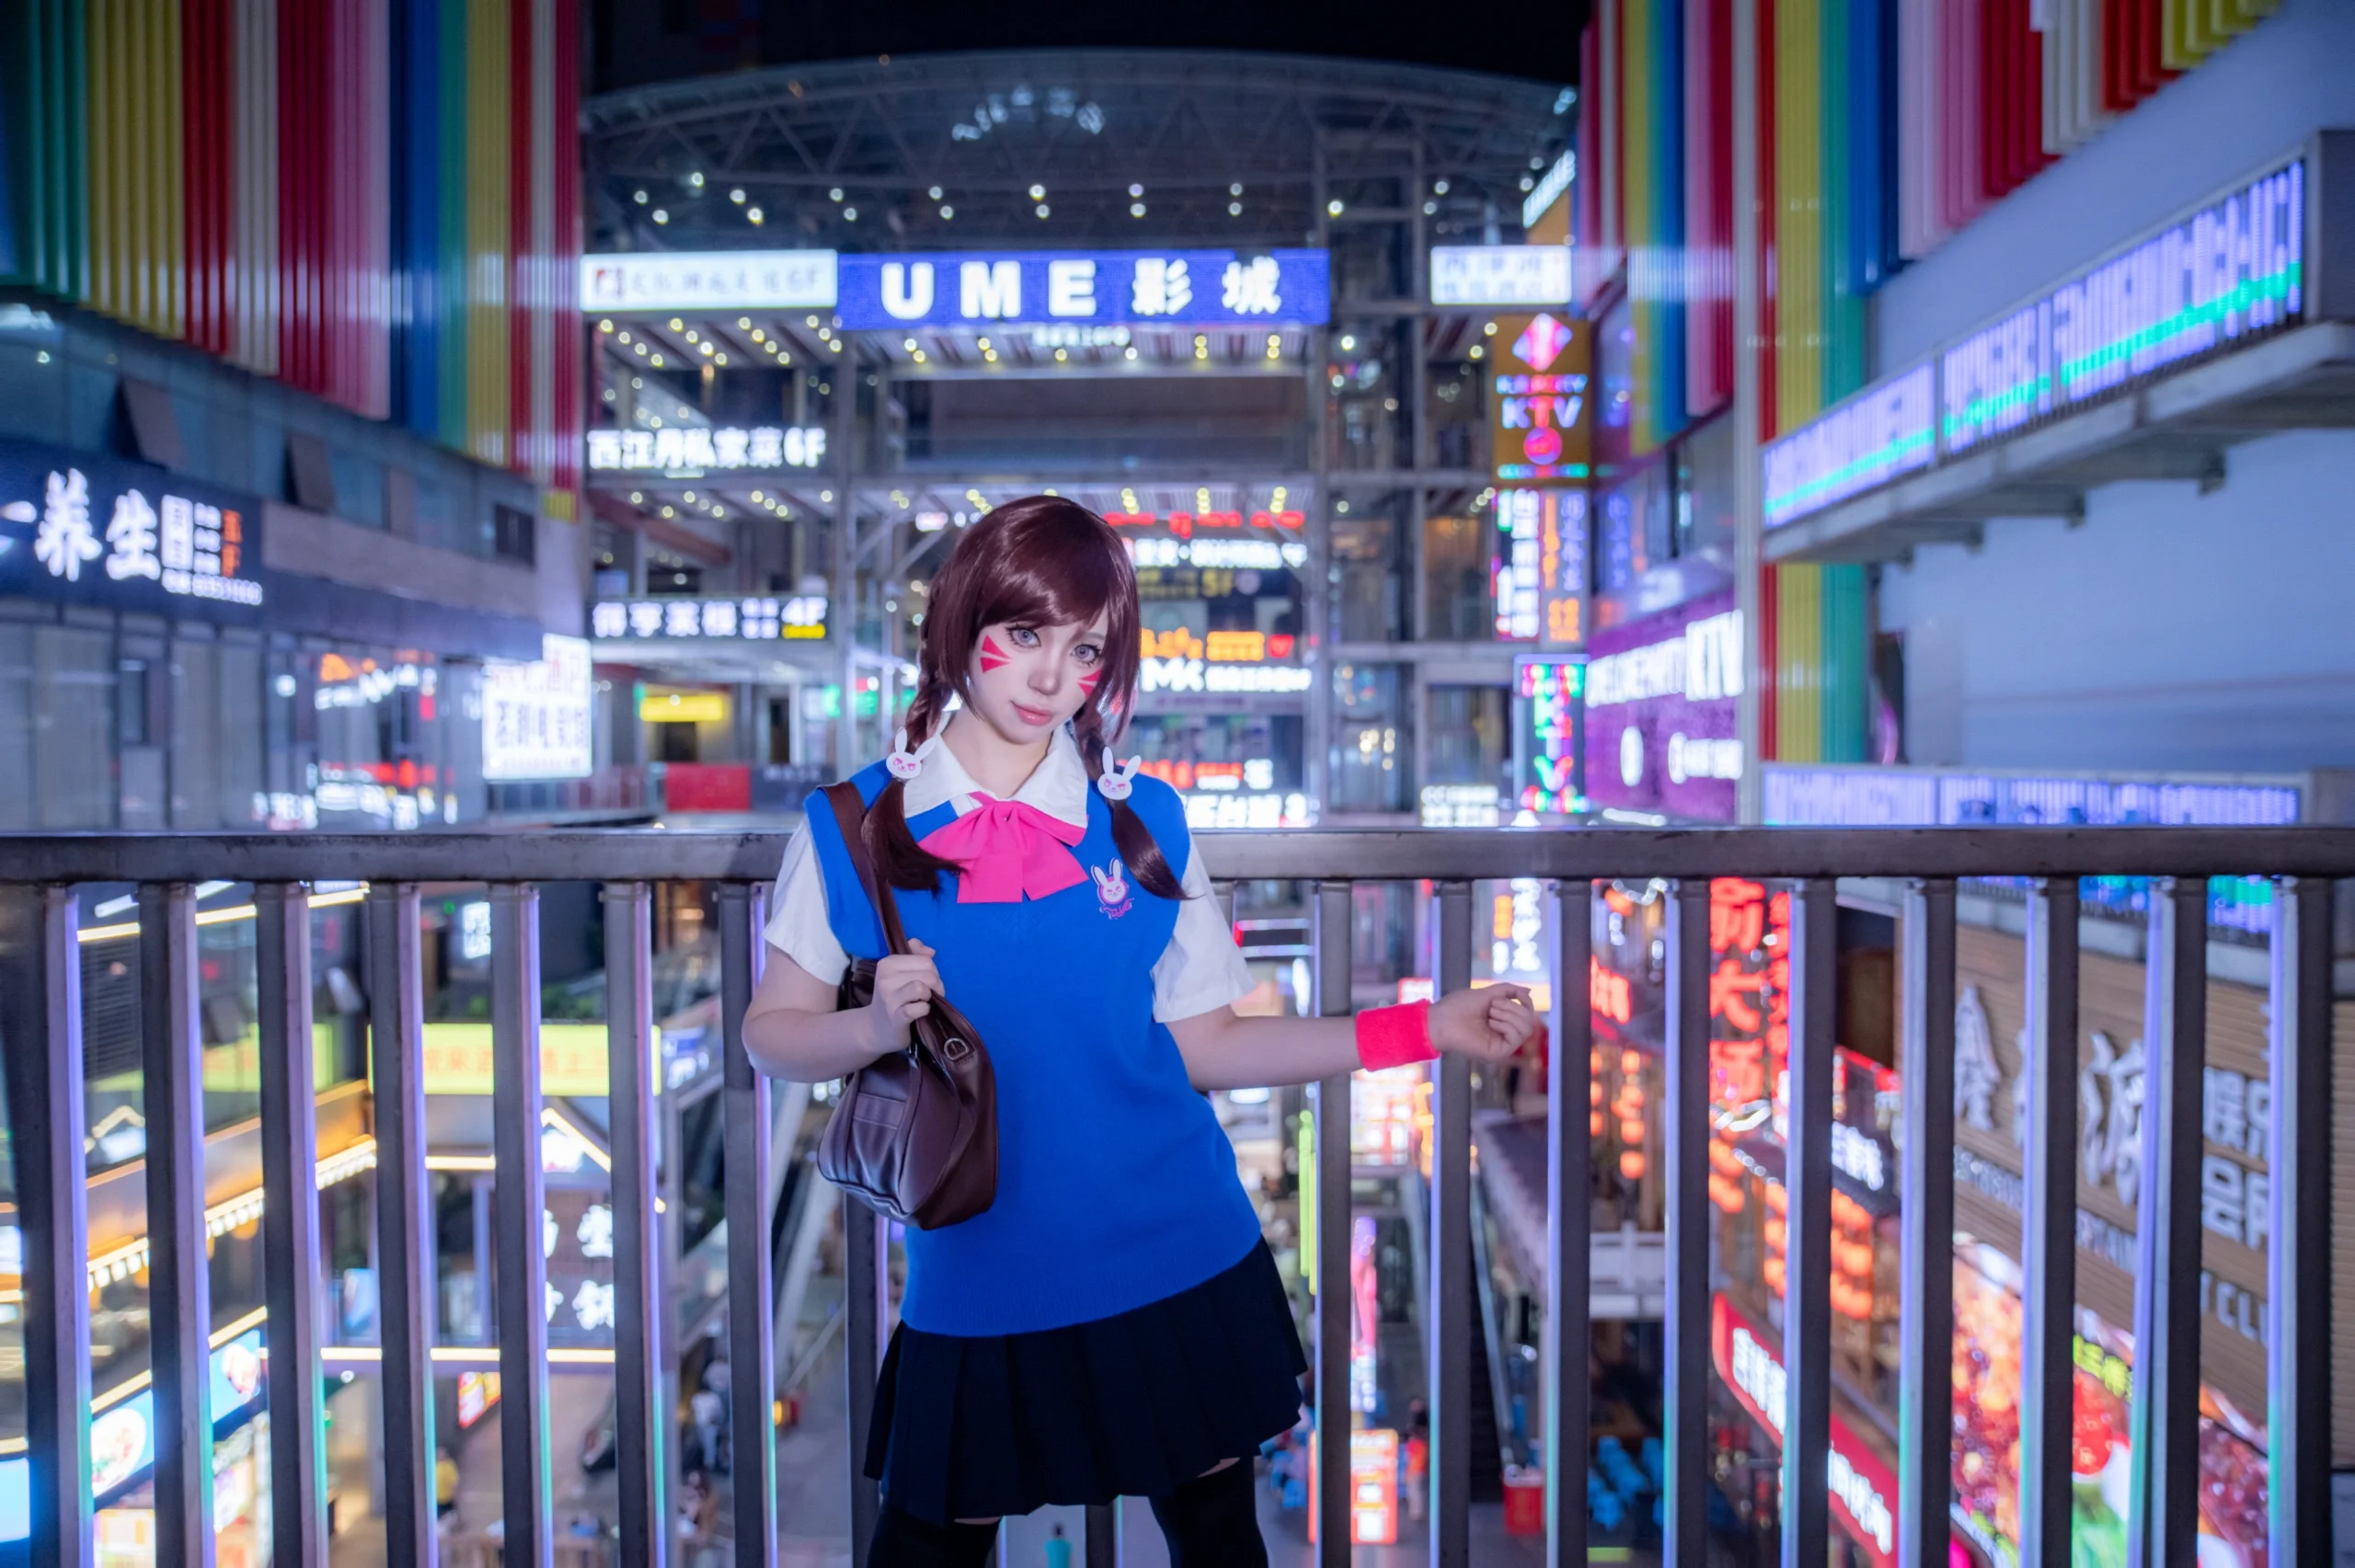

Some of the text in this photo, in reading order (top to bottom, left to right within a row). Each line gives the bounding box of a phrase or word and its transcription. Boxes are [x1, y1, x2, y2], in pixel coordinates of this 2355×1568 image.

[880, 260, 1097, 320] UME
[1132, 257, 1282, 315] 影城
[1501, 395, 1583, 429] KTV
[0, 467, 162, 582] 养生
